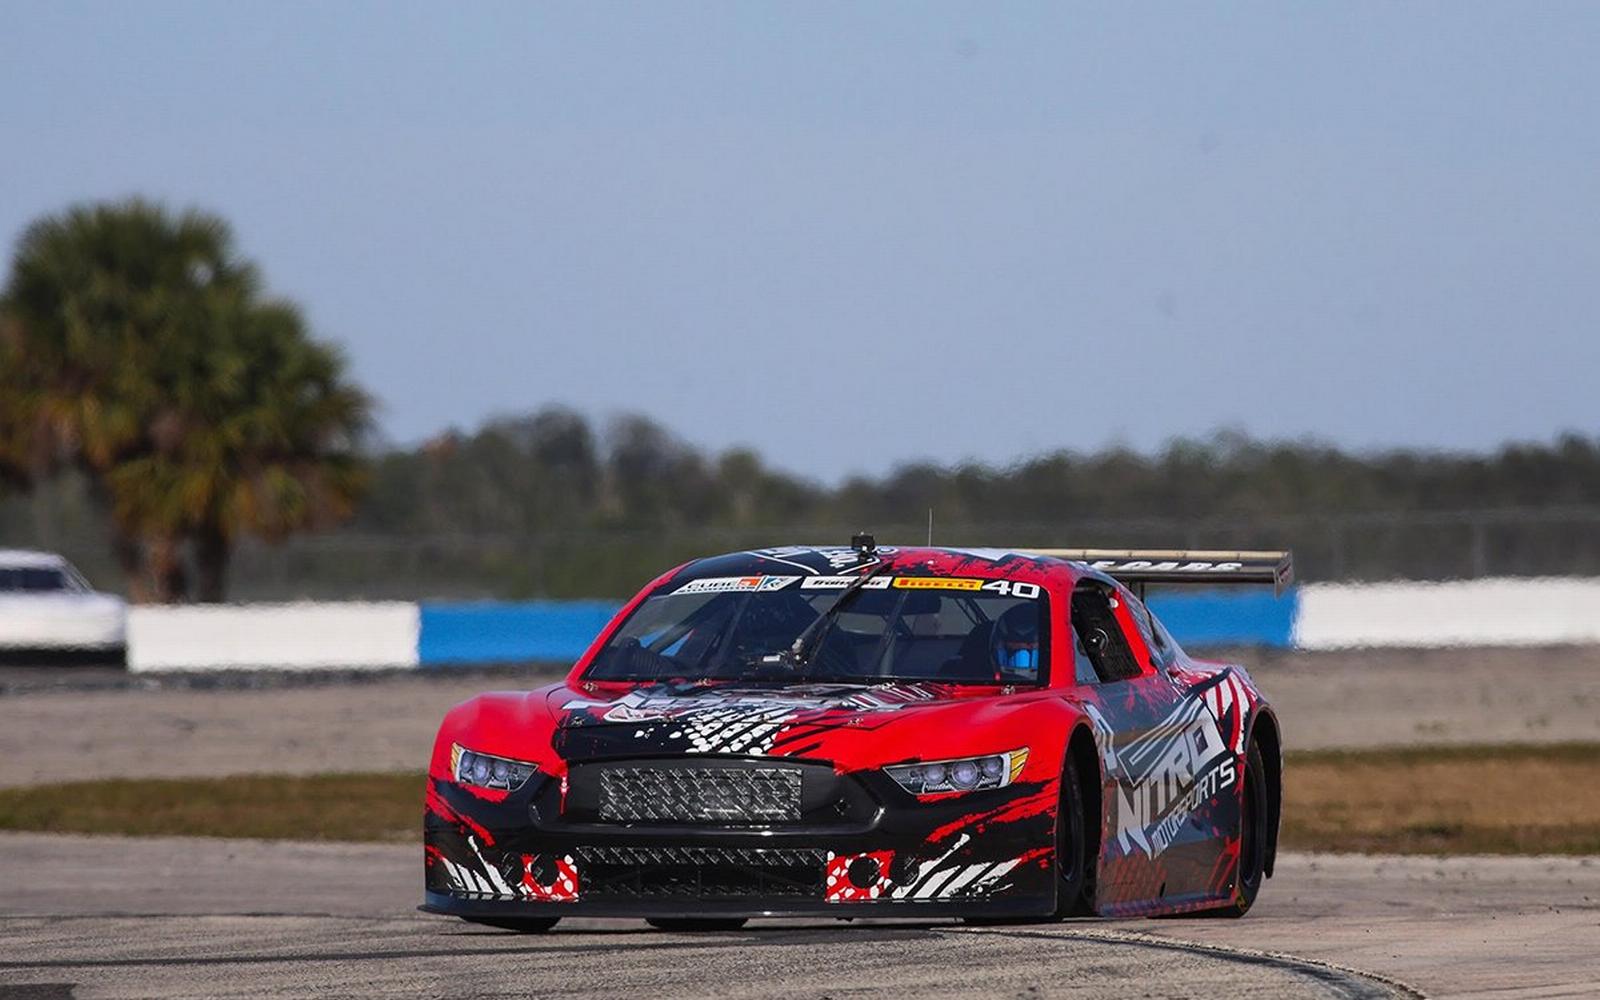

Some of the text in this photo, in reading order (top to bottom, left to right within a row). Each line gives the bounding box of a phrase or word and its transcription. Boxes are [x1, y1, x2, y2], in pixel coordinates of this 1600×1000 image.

[899, 578, 978, 588] PIRELLI
[981, 579, 1041, 599] 40
[1116, 703, 1227, 861] NITRO
[1150, 756, 1236, 859] MOTORSPORTS
